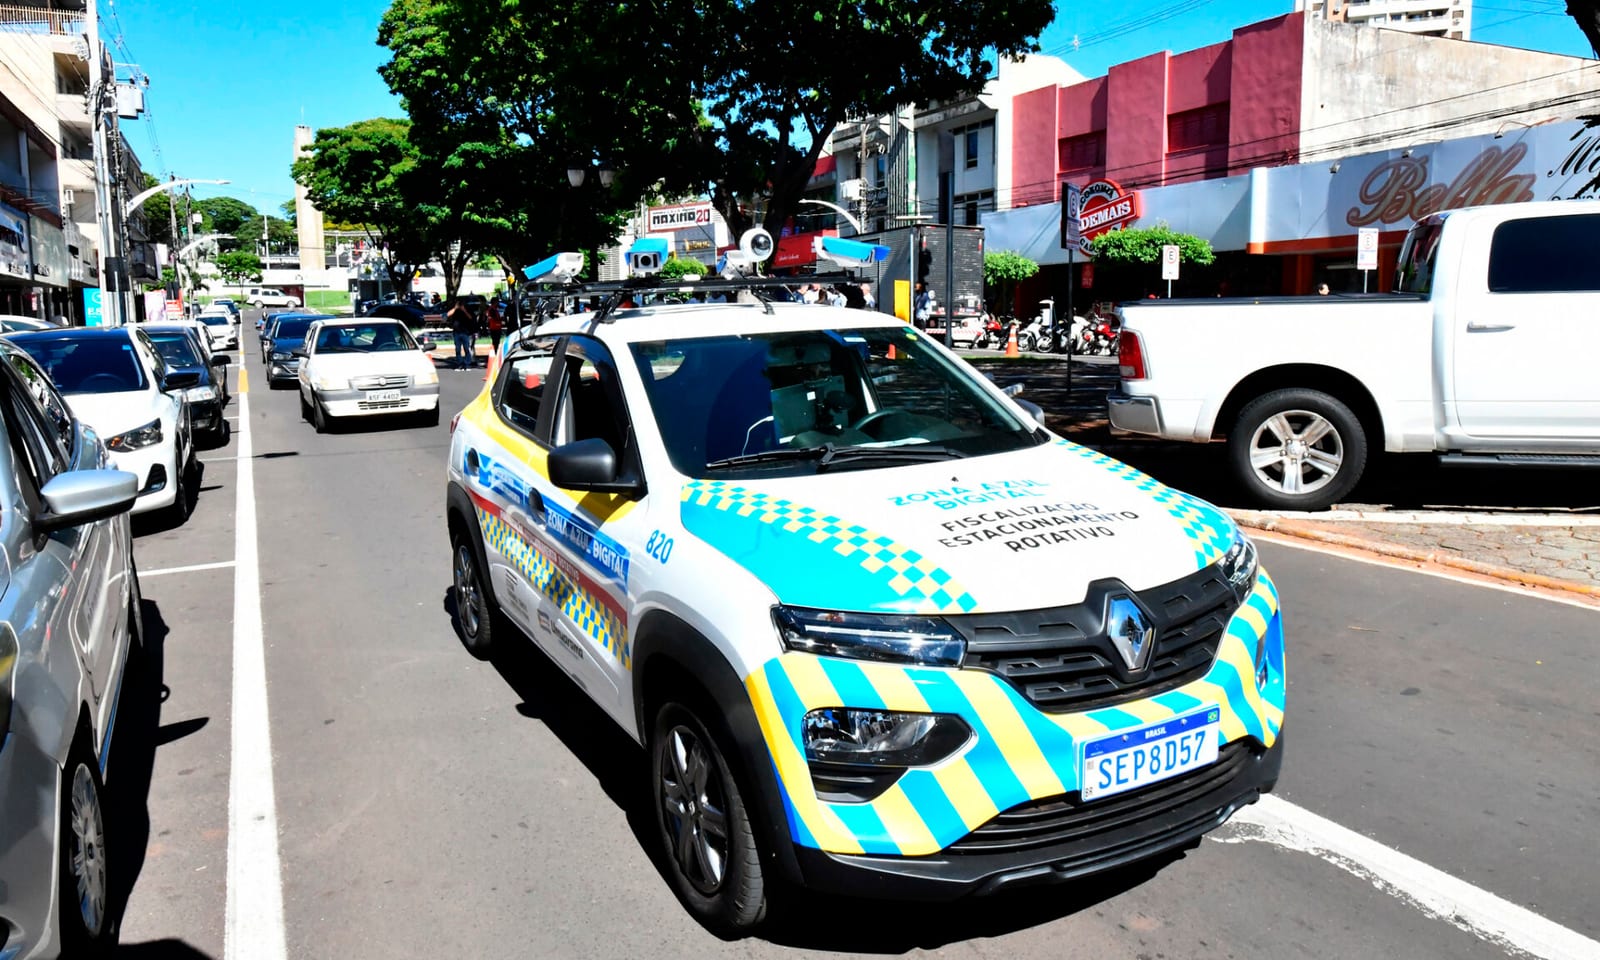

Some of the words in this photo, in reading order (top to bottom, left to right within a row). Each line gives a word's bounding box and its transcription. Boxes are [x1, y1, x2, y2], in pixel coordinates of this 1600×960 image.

[1079, 200, 1131, 231] DEMAIS
[887, 485, 971, 507] ZONA
[980, 479, 1050, 491] AZUL
[547, 510, 569, 538] ZONA
[937, 510, 1140, 548] ESTACIONAMENTO
[940, 502, 1100, 532] FISCALIZAÇÃO
[645, 529, 675, 565] 820
[1003, 526, 1116, 552] ROTATIVO
[1145, 727, 1167, 740] BRASIL
[1098, 730, 1206, 790] SEP8D57
